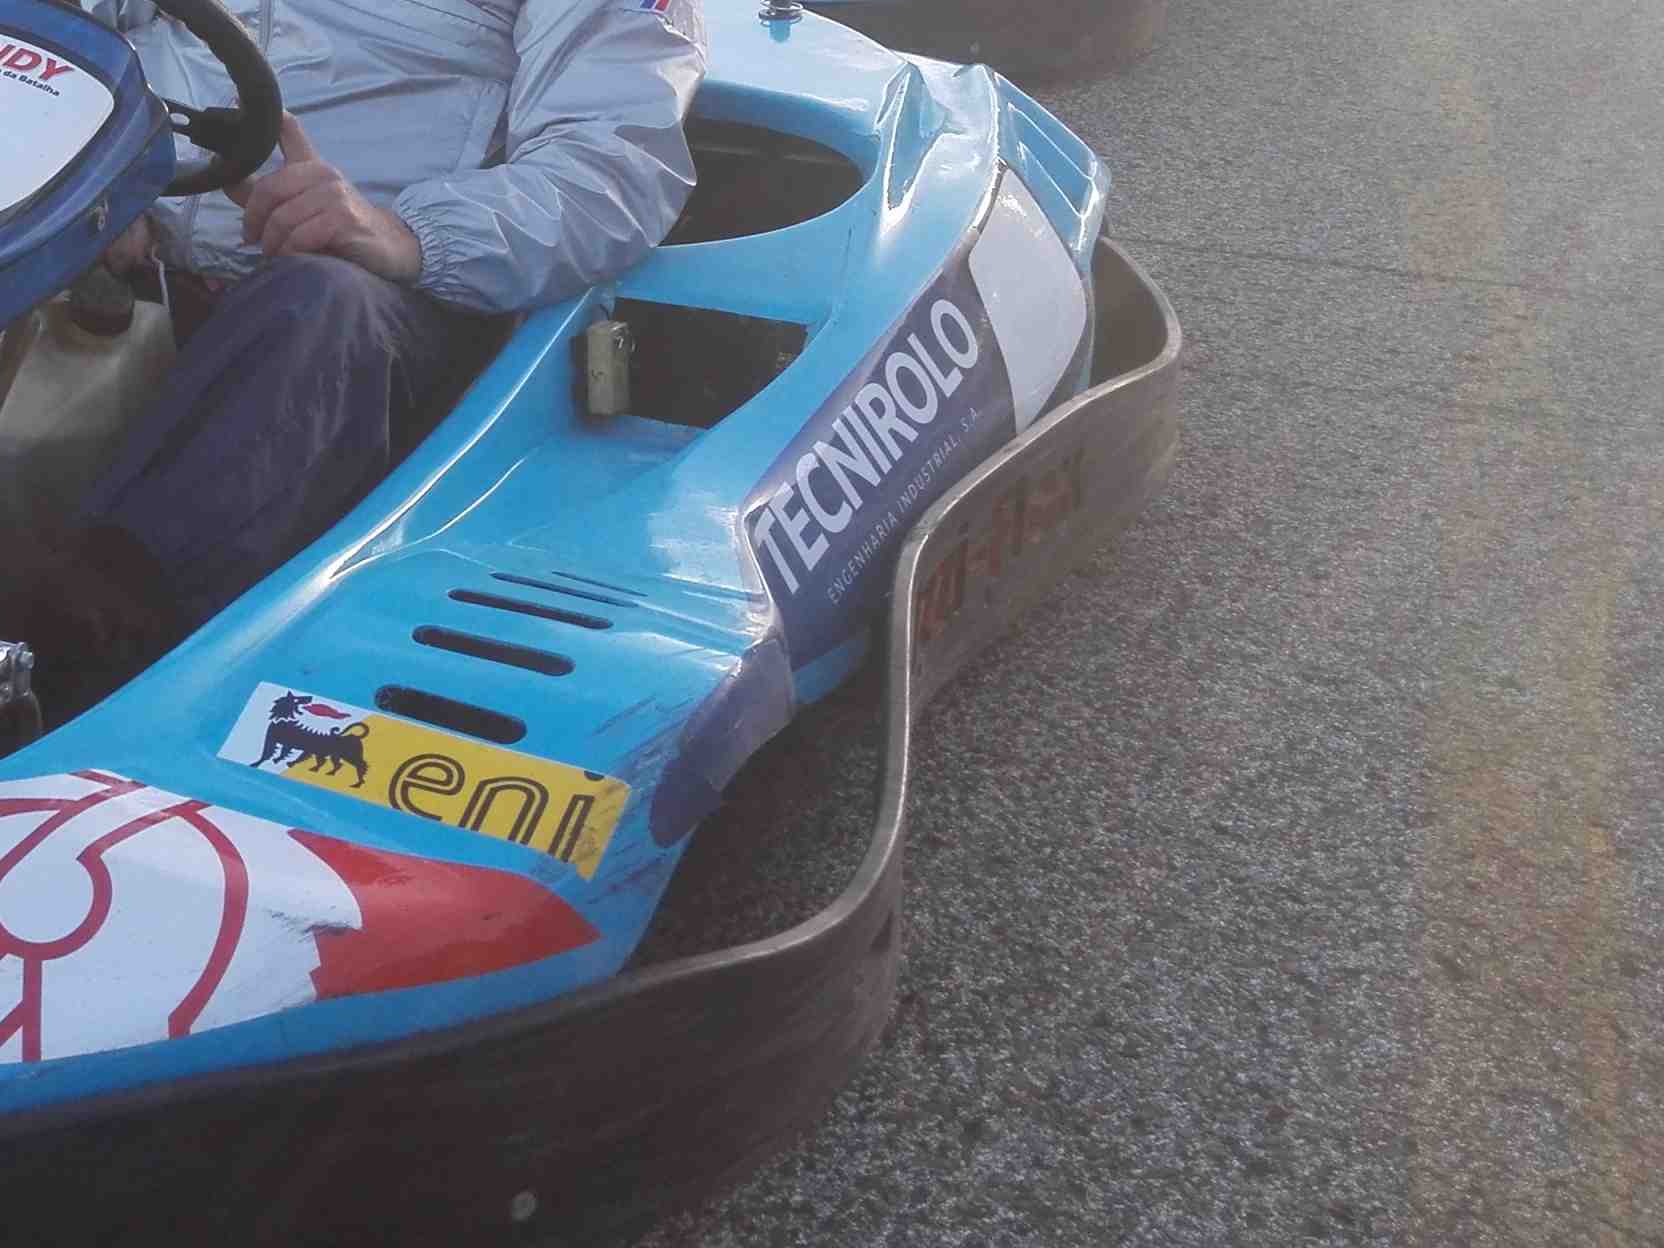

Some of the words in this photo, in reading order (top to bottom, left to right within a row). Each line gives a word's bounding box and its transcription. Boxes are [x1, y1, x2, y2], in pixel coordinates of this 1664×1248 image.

[18, 73, 60, 97] Batalha
[754, 298, 978, 594] TECNIROLO
[826, 510, 898, 605] ENGENHARIA
[388, 753, 606, 862] eni
